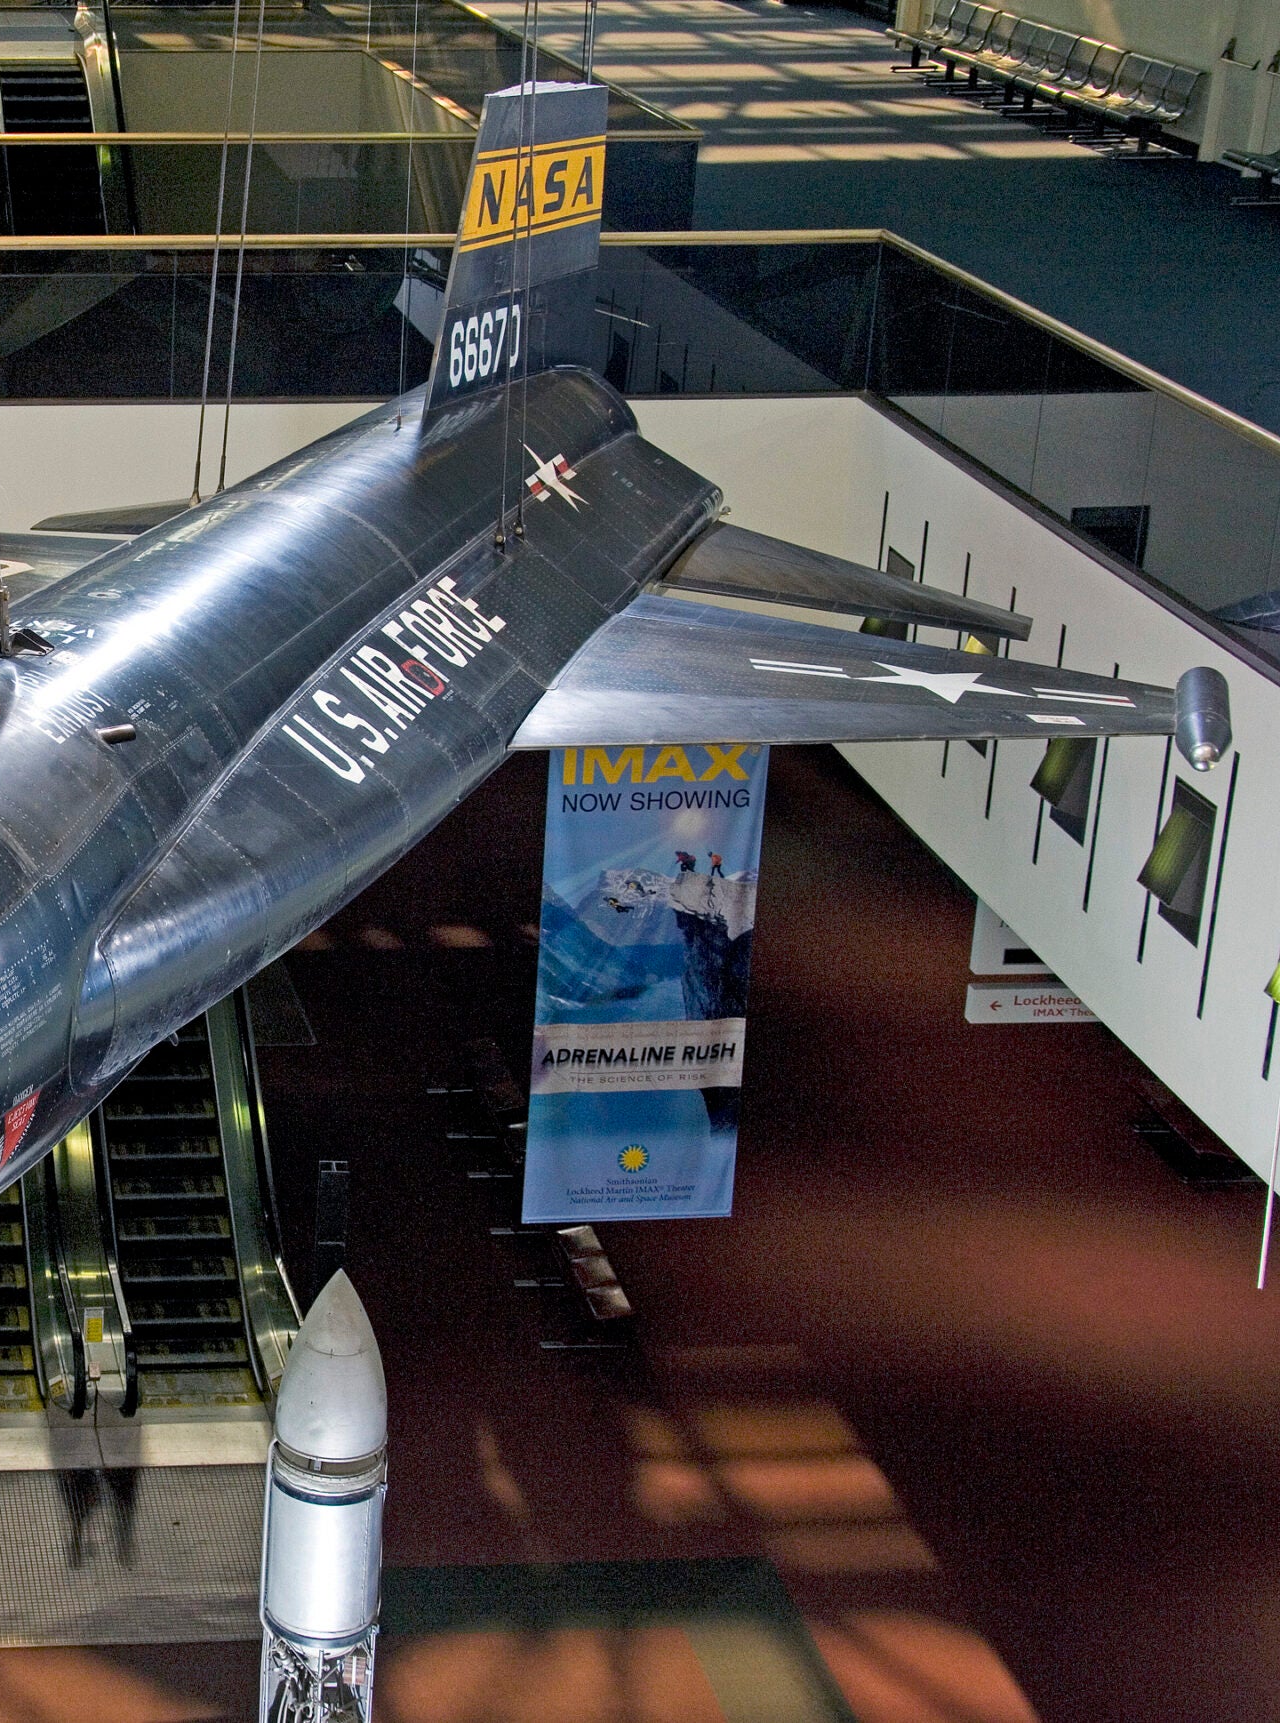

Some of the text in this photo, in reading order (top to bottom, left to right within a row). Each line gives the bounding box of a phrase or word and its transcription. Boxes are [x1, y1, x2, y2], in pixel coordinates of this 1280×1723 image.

[477, 156, 594, 228] NASA
[281, 575, 507, 785] U.S. AIR FORCE
[562, 788, 750, 813] NOW SHOWING
[542, 1043, 736, 1065] ADRENALINE RUSH
[570, 1073, 707, 1085] THE SCIENCE OF RISK
[566, 1187, 604, 1196] Lockheed
[606, 1187, 633, 1195] Martin
[606, 1177, 658, 1186] Smithsonian
